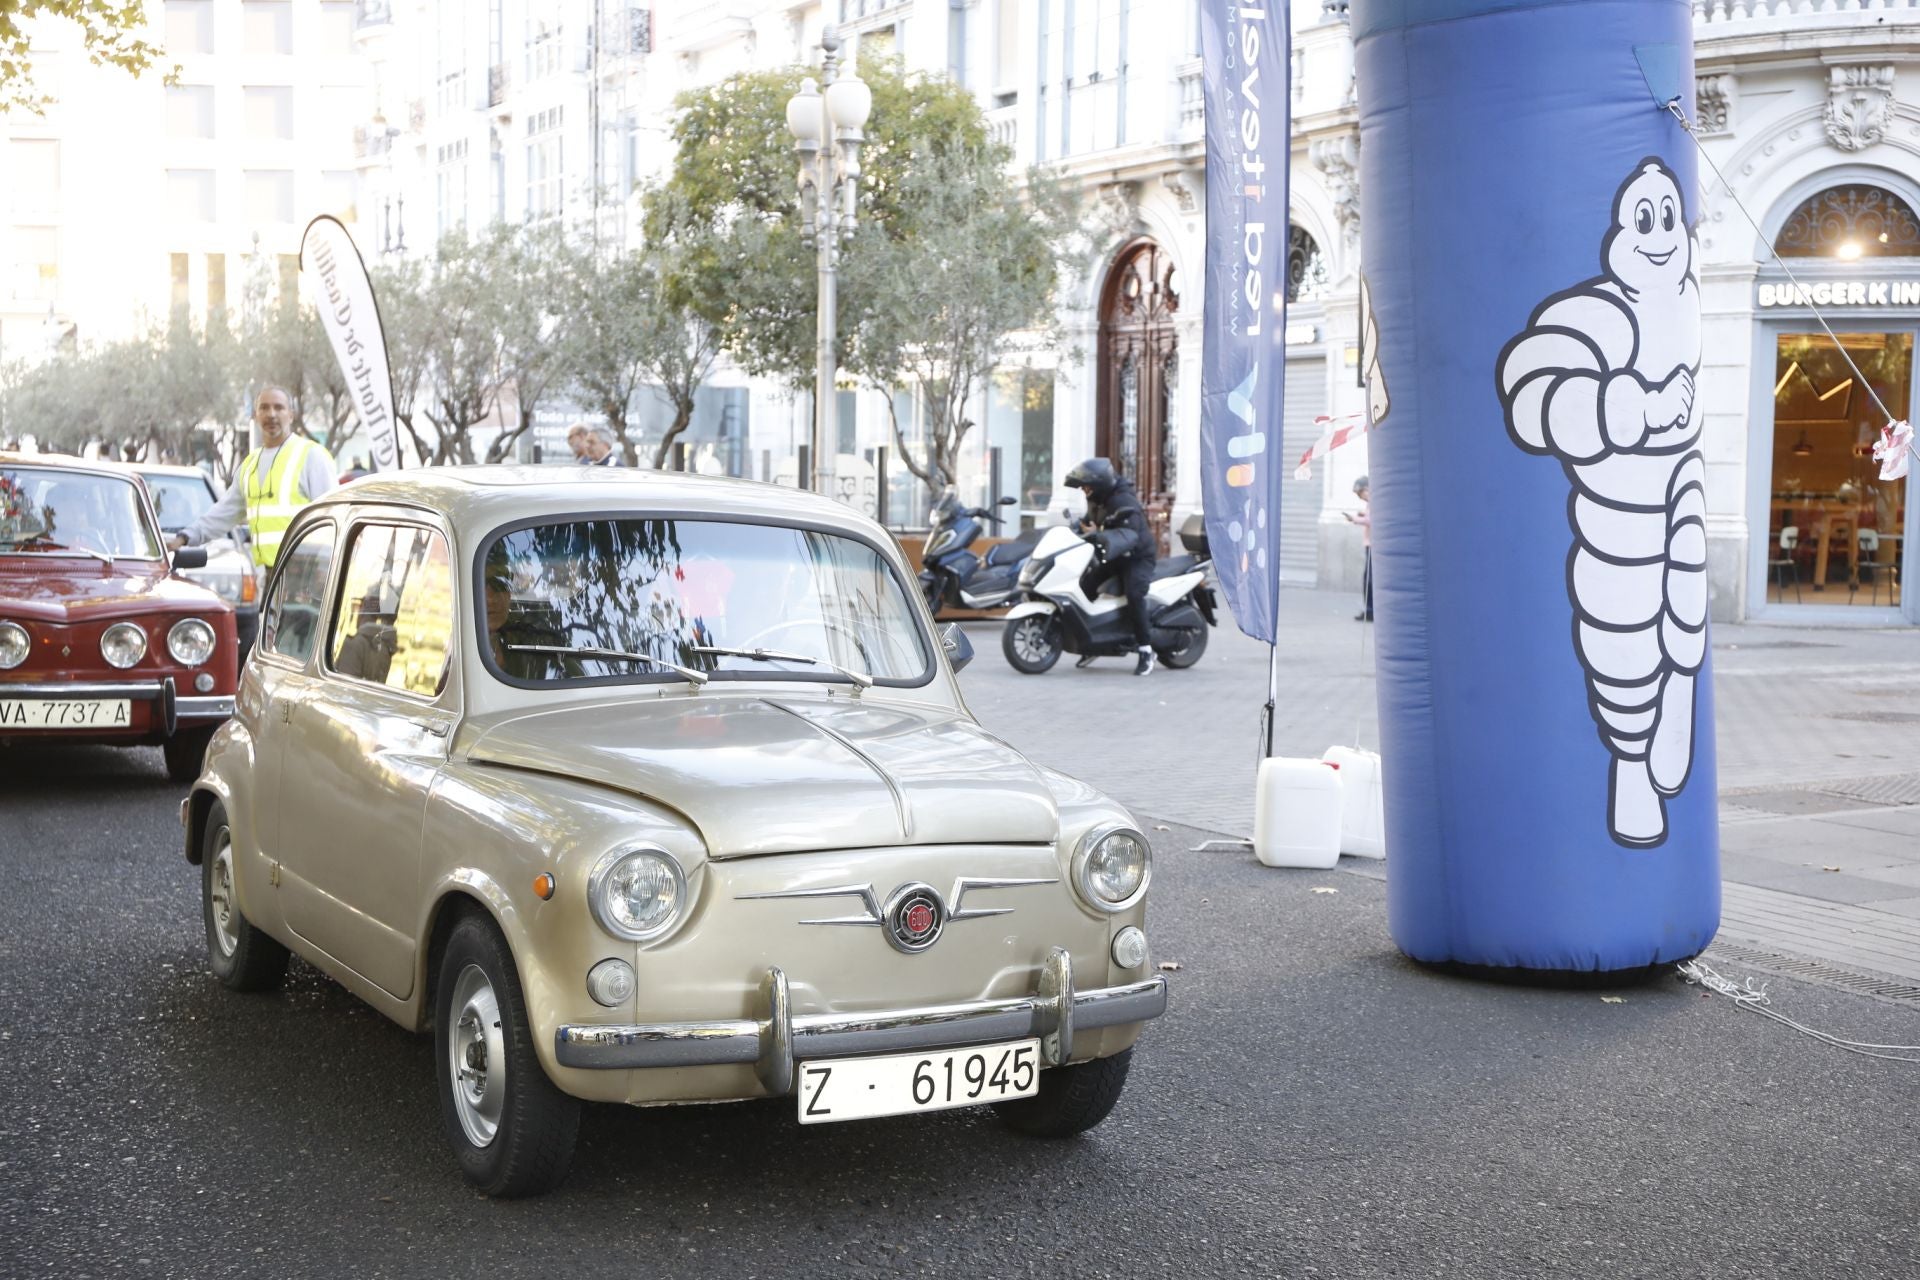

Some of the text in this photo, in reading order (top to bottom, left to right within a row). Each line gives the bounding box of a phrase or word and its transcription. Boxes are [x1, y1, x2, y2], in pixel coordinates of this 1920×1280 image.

[1758, 282, 1866, 307] BURGER
[534, 410, 564, 423] Todo
[911, 911, 929, 927] 600
[806, 1067, 832, 1116] Z
[912, 1046, 1035, 1105] 61945
